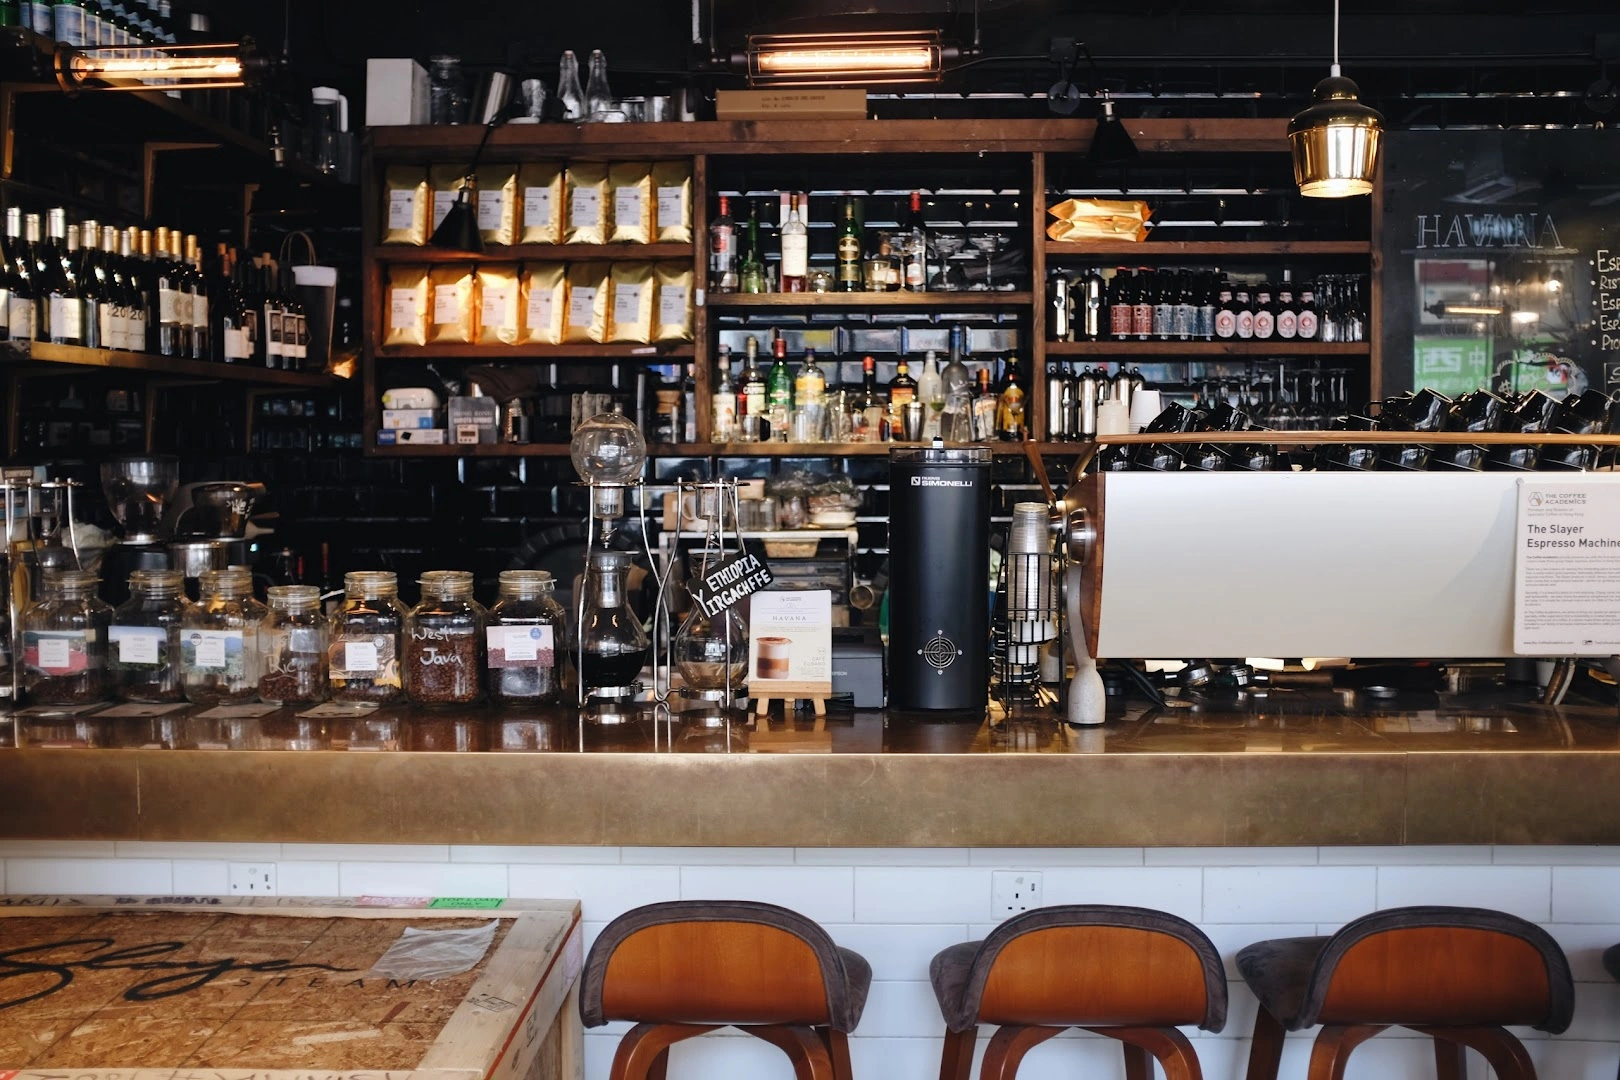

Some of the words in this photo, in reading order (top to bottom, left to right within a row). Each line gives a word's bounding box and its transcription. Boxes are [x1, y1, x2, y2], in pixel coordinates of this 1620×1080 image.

[1416, 213, 1564, 249] HAVANA
[1527, 524, 1547, 534] The
[1549, 524, 1584, 535] Slayer
[1527, 538, 1576, 550] Espresso
[1578, 538, 1620, 548] Machine
[706, 553, 762, 593] ETHIOPIA
[692, 568, 772, 618] YIRGACHFFE
[419, 647, 464, 667] Java
[233, 976, 421, 990] STEAM
